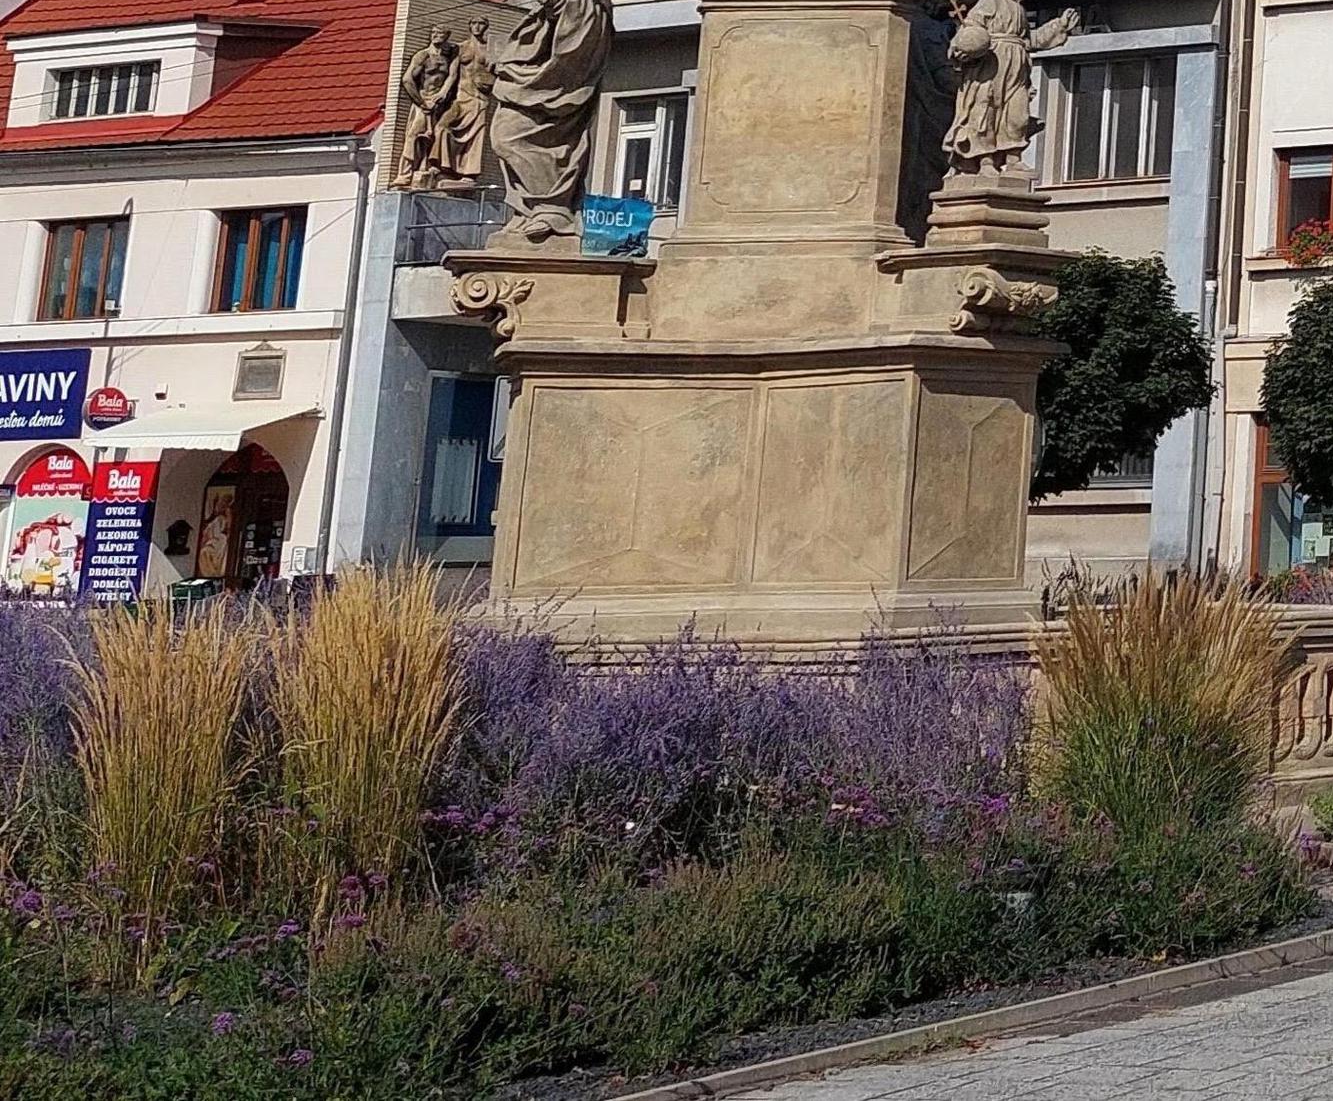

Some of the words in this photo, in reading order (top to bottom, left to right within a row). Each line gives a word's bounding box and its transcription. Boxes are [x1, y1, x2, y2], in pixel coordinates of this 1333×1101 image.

[97, 393, 123, 407] Bala
[48, 455, 73, 470] Bala
[108, 469, 141, 489] Bala
[105, 506, 137, 516] OVOCE
[96, 519, 142, 528] ZELENINA
[95, 530, 139, 540] ALKOHOL
[97, 541, 135, 552] NÁPOJE
[91, 555, 139, 565] CIGARETY
